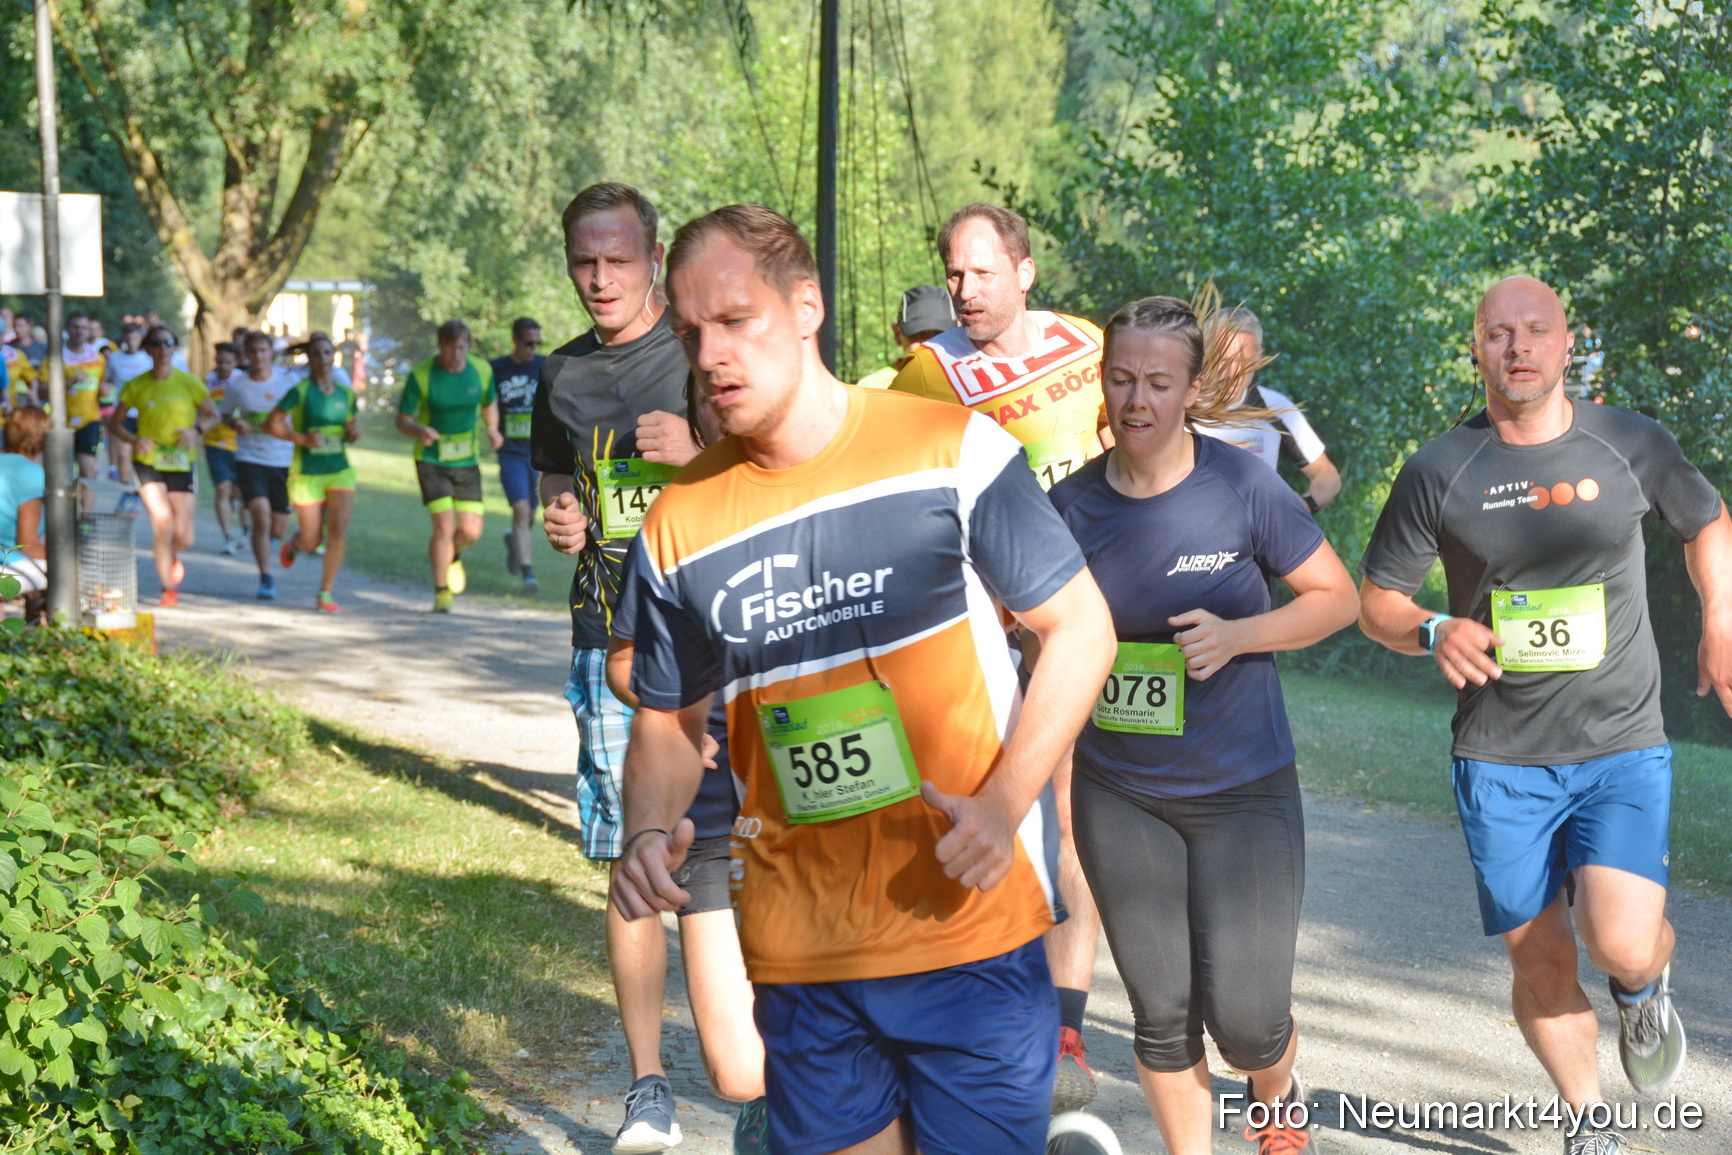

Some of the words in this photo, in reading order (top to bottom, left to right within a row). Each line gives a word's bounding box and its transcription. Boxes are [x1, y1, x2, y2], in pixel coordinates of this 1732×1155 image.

[985, 394, 1041, 427] AX
[1034, 459, 1072, 487] 17
[1490, 481, 1528, 495] APTIV
[1482, 499, 1516, 510] Running
[1517, 495, 1538, 504] Team
[1167, 554, 1218, 576] JURA
[741, 567, 893, 631] Fischer
[764, 600, 884, 645] AUTOMOBILE
[1527, 618, 1571, 648] 36
[1113, 707, 1156, 717] Rosmarie
[788, 733, 871, 788] 585
[836, 779, 876, 795] Stefan
[863, 784, 891, 798] GmbH
